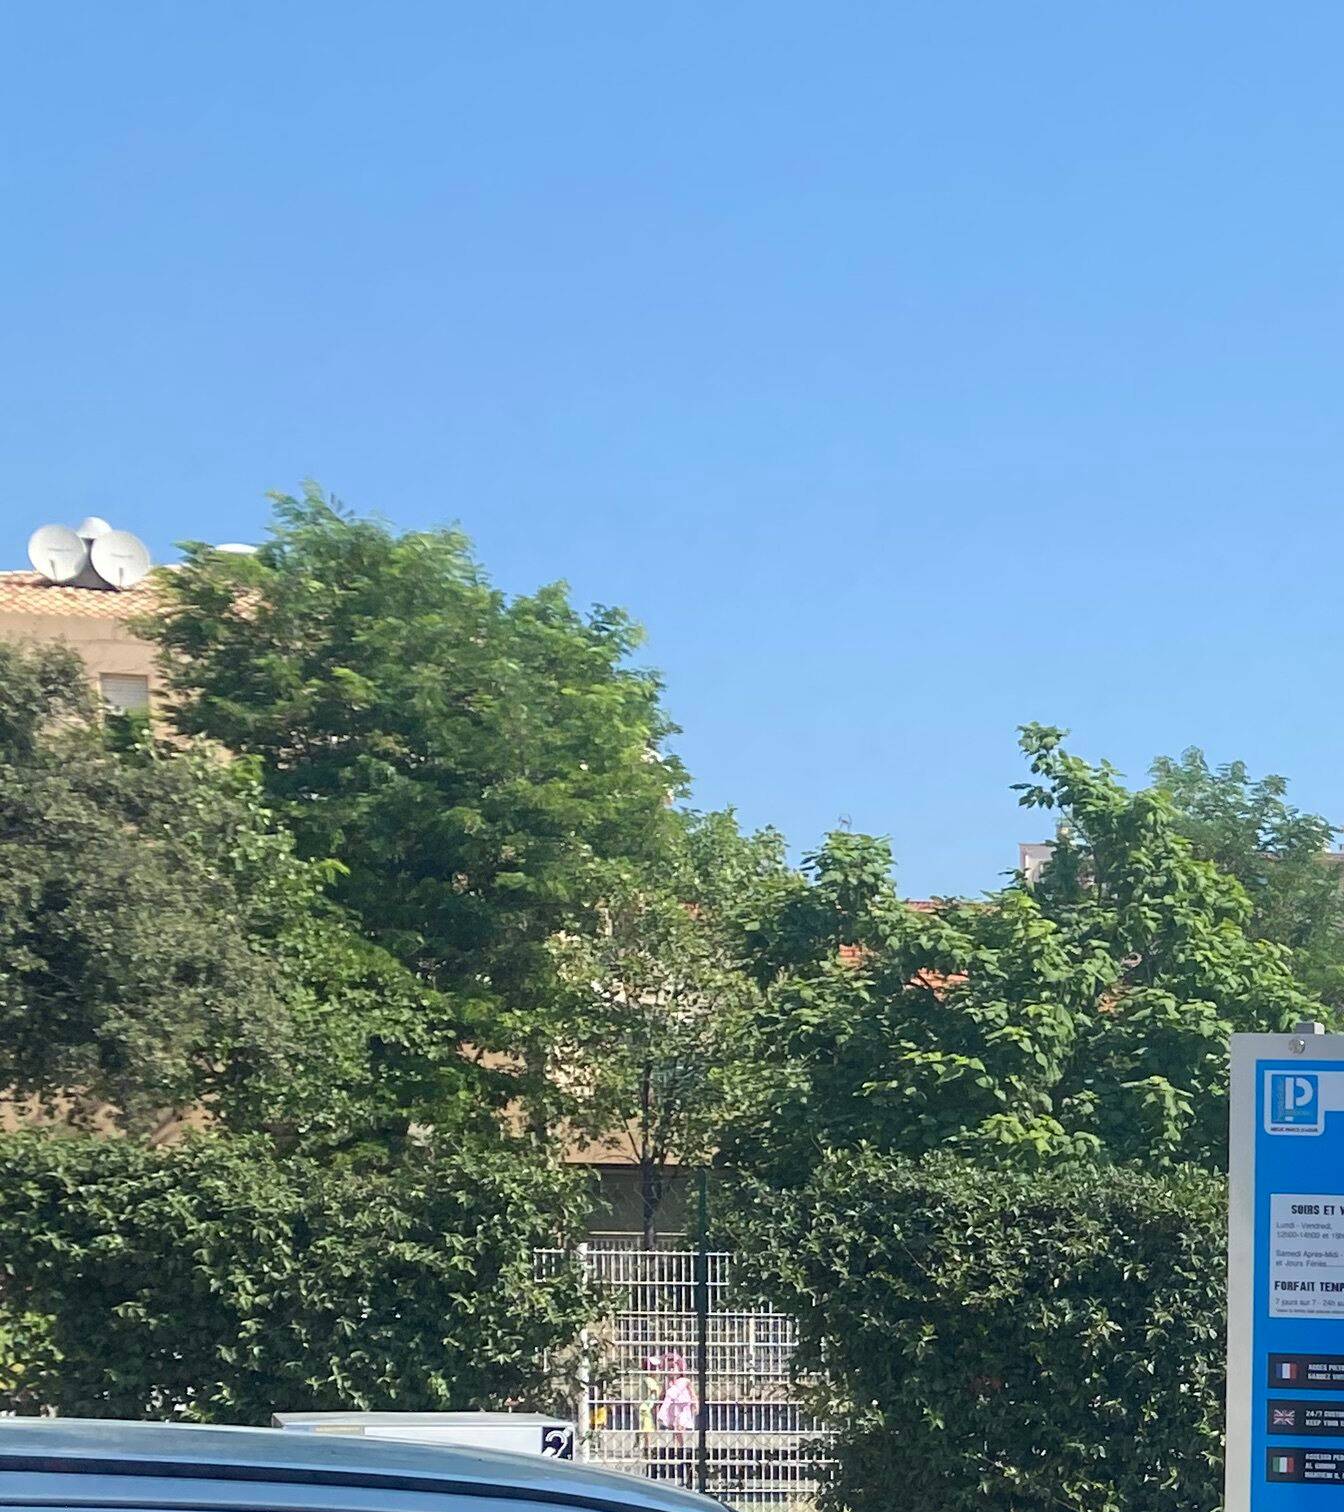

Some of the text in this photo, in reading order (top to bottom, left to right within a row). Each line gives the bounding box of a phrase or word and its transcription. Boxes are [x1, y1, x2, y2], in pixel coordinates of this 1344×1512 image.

[1291, 1205, 1320, 1215] SOIRS
[1324, 1205, 1335, 1216] ET
[1274, 1281, 1315, 1292] FORFAIT
